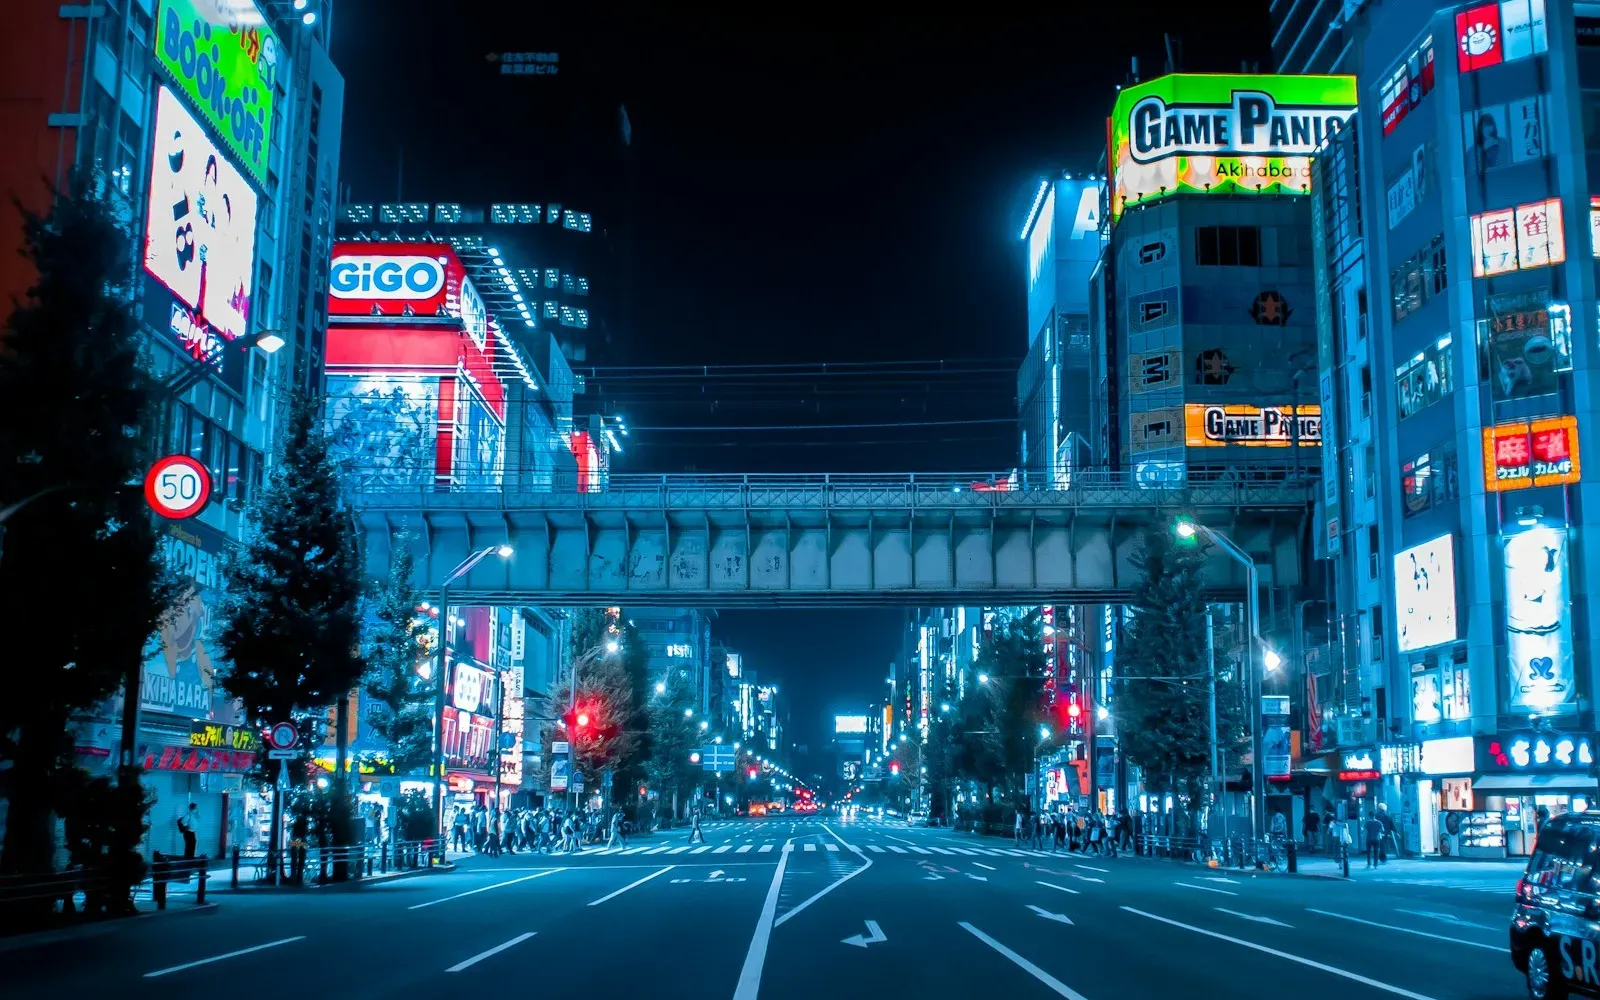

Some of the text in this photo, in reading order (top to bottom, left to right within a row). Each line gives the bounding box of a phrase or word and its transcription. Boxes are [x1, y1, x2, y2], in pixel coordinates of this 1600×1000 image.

[1134, 98, 1229, 153] GAME
[1486, 212, 1547, 244] 麻雀
[330, 262, 438, 292] GiGO
[1207, 409, 1258, 436] GAME
[161, 473, 196, 501] 50
